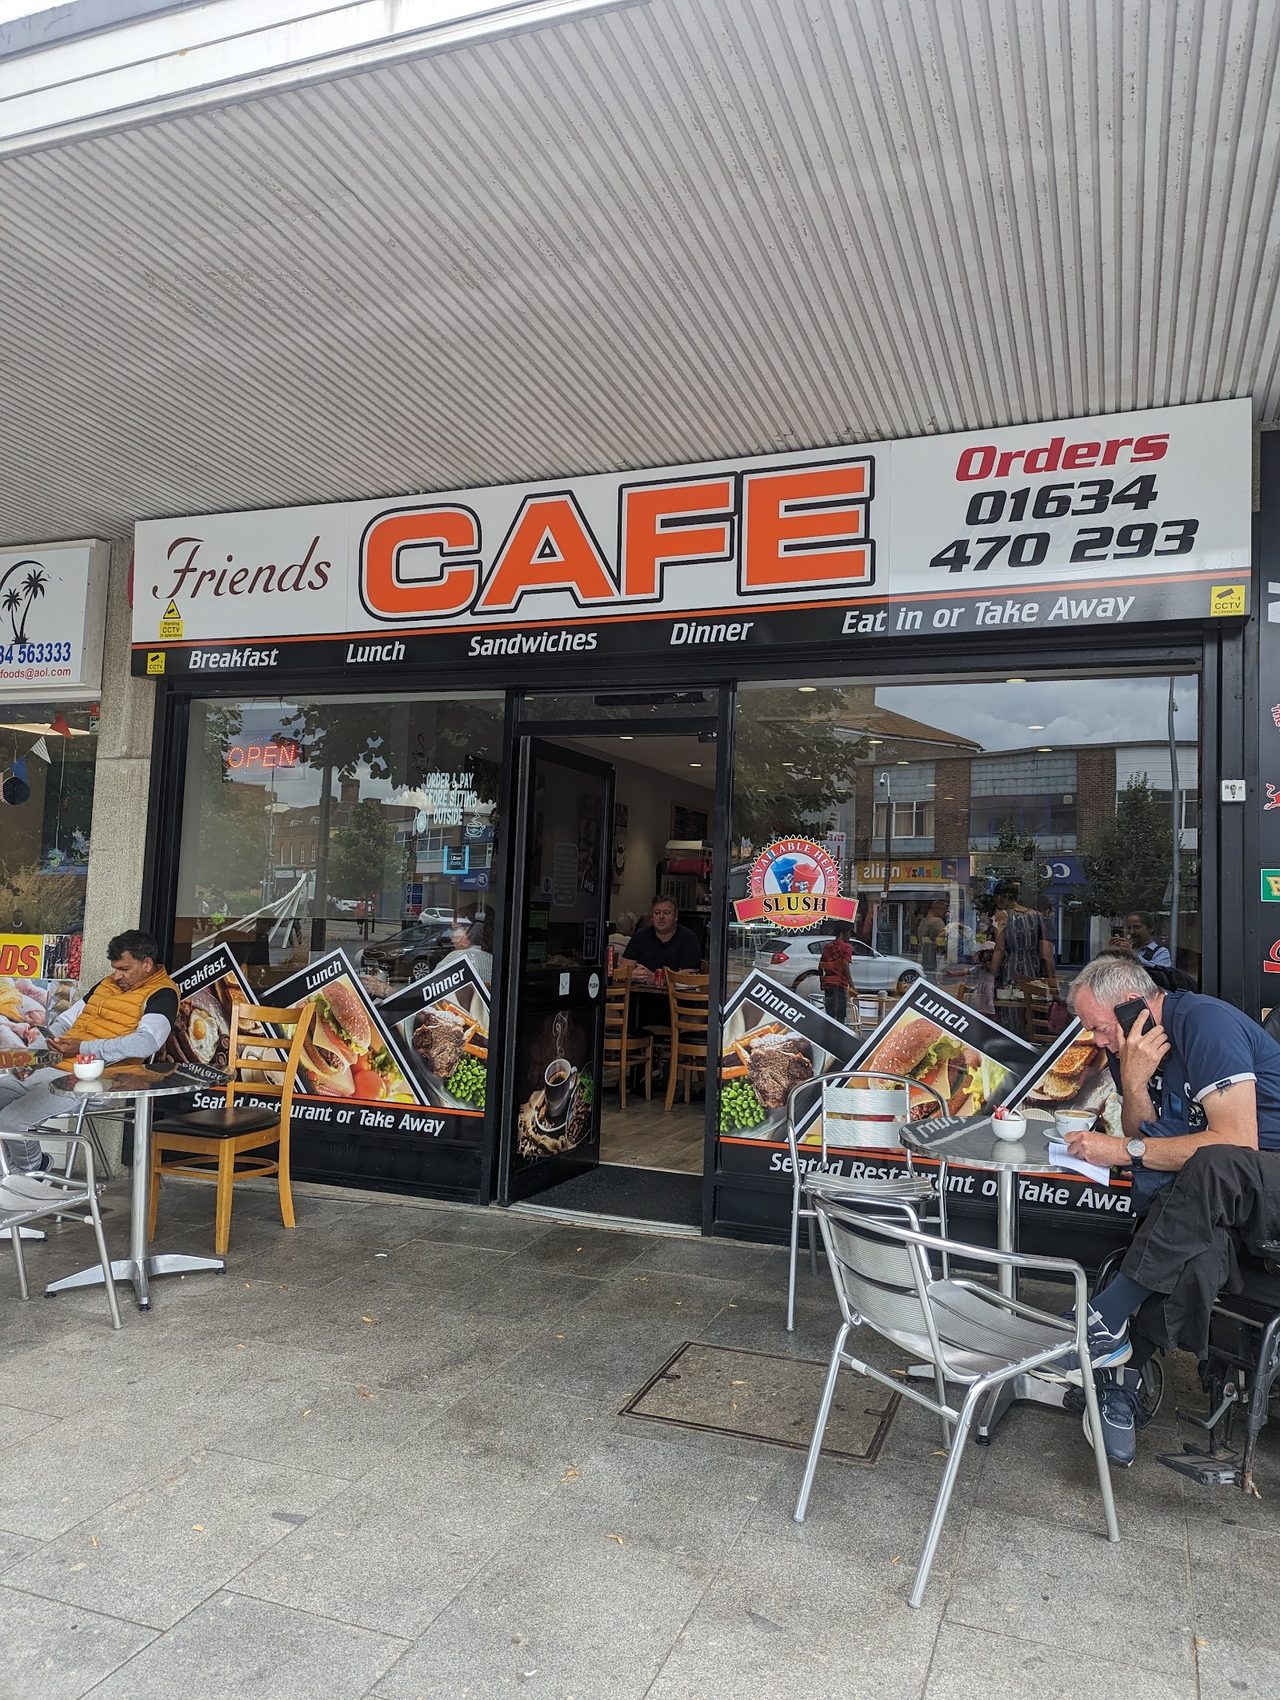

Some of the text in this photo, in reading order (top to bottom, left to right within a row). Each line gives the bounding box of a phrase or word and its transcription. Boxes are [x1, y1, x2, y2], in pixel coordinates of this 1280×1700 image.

[955, 433, 1170, 482] Orders
[965, 474, 1159, 526] 01634
[358, 455, 875, 622] CAFE
[929, 519, 1200, 574] 470 293
[152, 535, 331, 600] Friends
[1214, 602, 1241, 610] CCTV
[188, 594, 1136, 670] Breakfast Lunch Sandwiches Dinner Eat in or Take Away
[18, 641, 71, 664] 563333
[228, 745, 296, 768] OPEN
[426, 772, 450, 789] ORDER
[460, 772, 474, 789] PAY
[449, 790, 478, 808] SITTING
[433, 808, 464, 826] OUTSIDE
[753, 842, 836, 884] AVAILABLE HERE
[763, 896, 828, 914] SLUSH
[175, 956, 227, 994] reakfast
[305, 960, 343, 990] Lunch
[421, 967, 466, 1002] Dinner
[750, 982, 807, 1025] Dinner
[914, 992, 970, 1034] Lunch
[192, 1092, 446, 1137] Seatd Resturant or Take Away
[981, 1179, 999, 1197] o
[1018, 1179, 1070, 1205] Take
[1076, 1187, 1138, 1218] Awa
